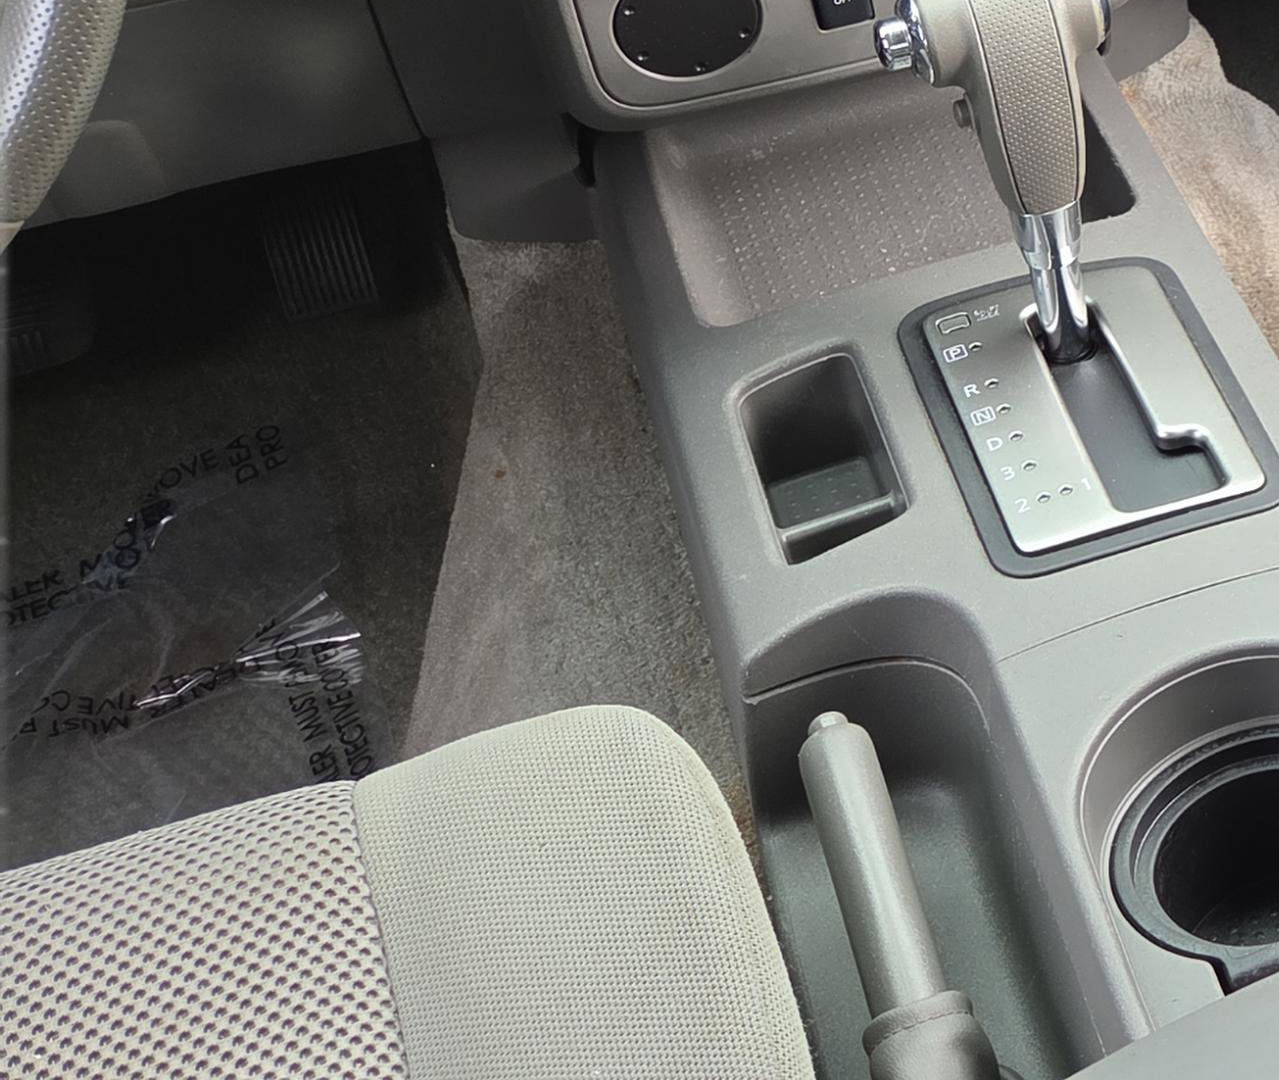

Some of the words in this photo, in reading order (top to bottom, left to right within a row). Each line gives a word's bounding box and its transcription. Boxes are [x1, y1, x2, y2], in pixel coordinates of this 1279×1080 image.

[963, 384, 981, 398] R
[986, 436, 1004, 452] D
[1000, 465, 1016, 481] 3
[1080, 477, 1092, 491] 1
[1014, 498, 1032, 514] 2
